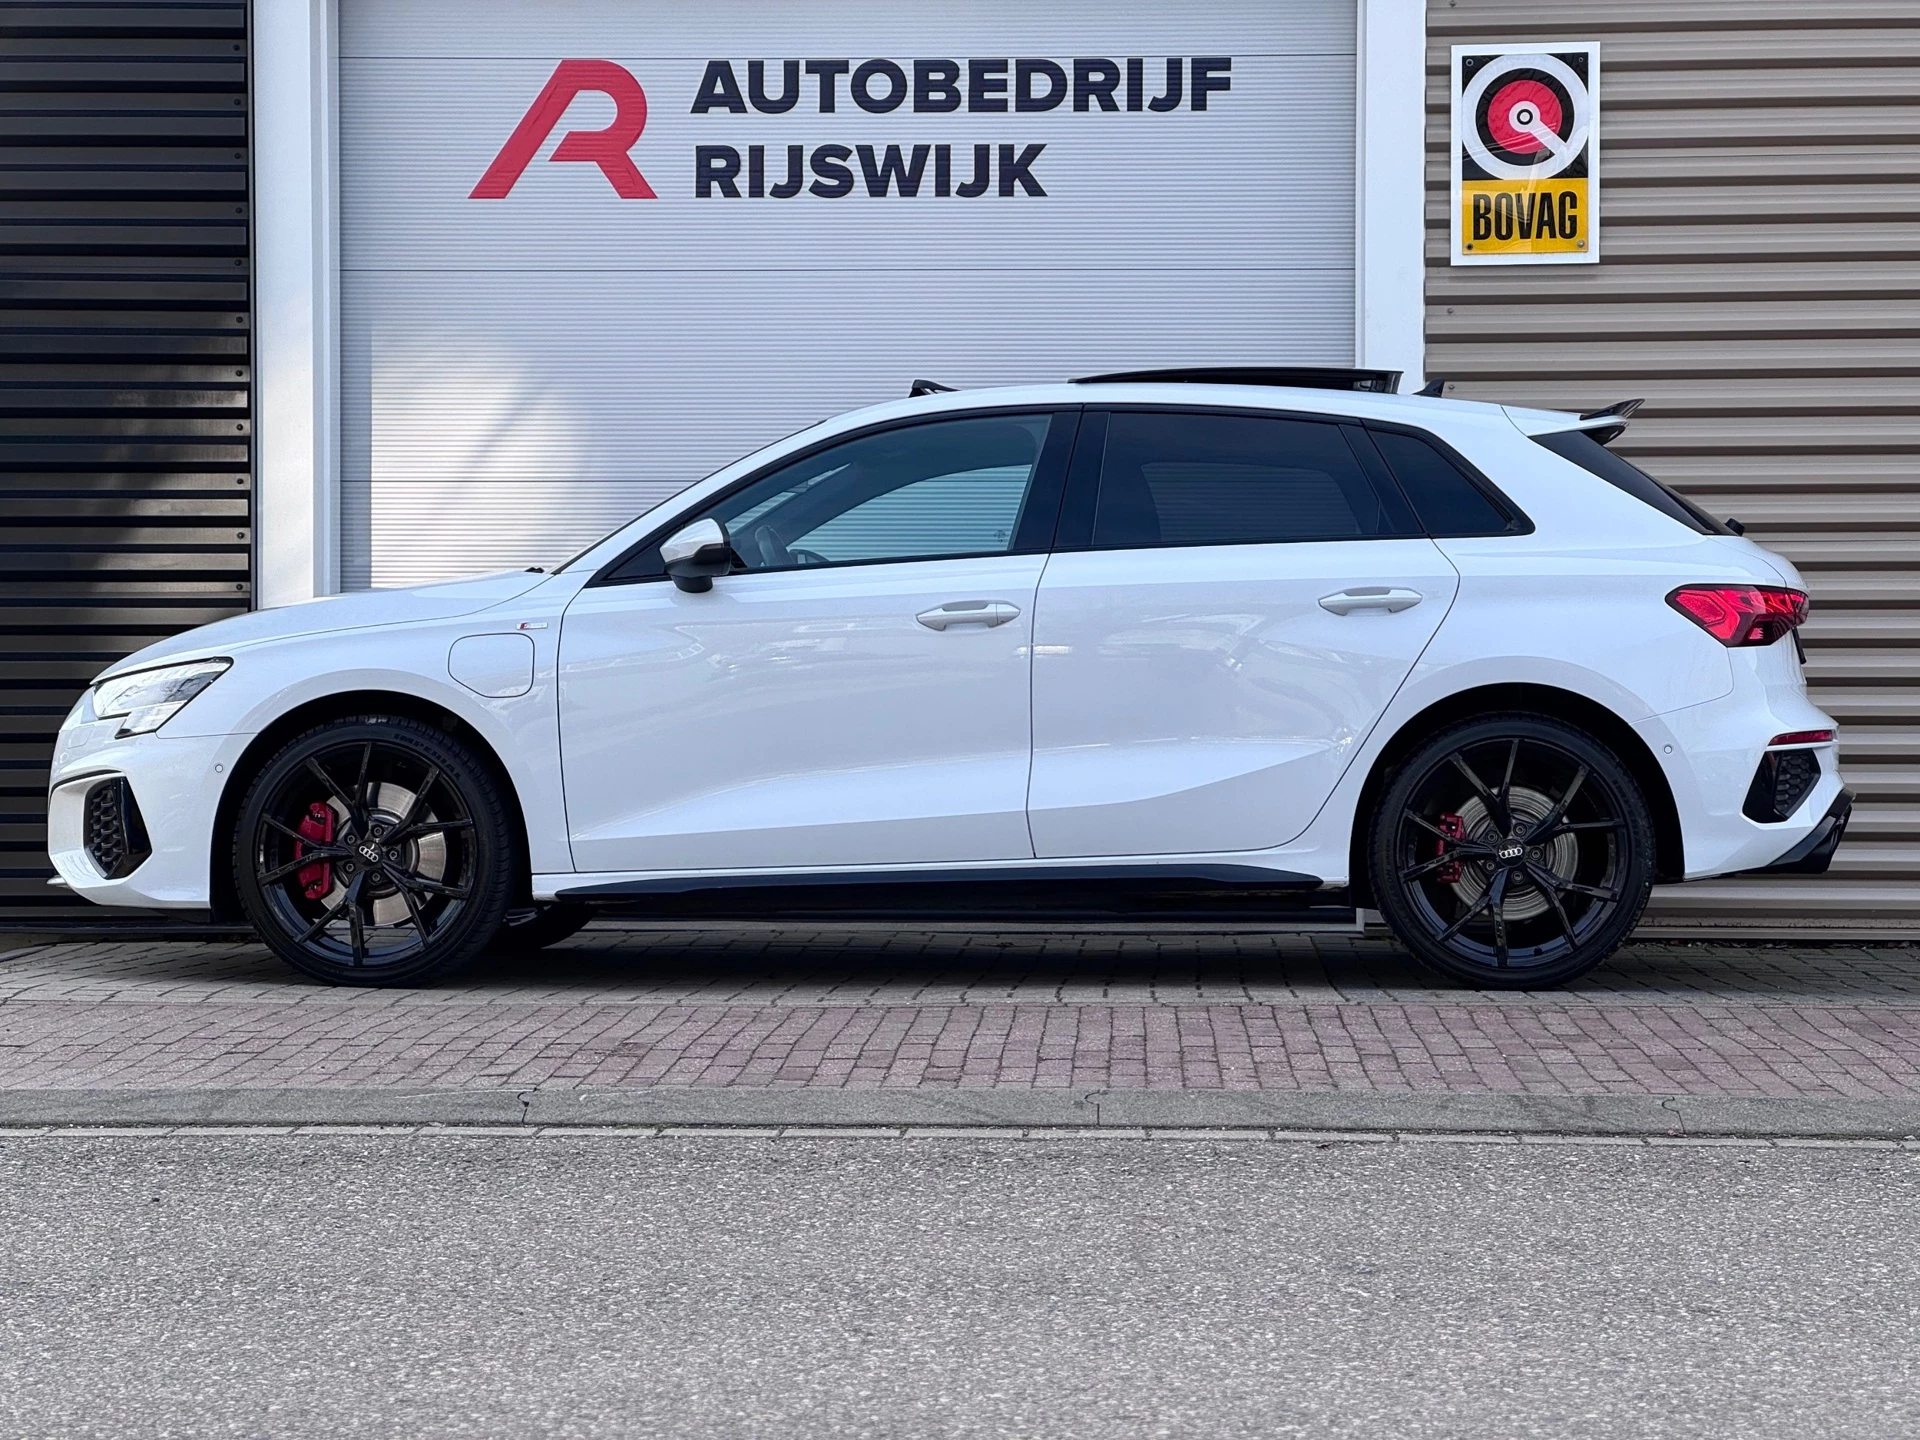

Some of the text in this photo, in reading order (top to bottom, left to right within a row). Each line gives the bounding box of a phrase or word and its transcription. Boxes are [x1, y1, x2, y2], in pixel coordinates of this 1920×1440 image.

[691, 58, 1231, 114] AUTOBEDRIJF
[696, 144, 1047, 198] RIJSWIJK
[1473, 191, 1578, 241] BOVAG
